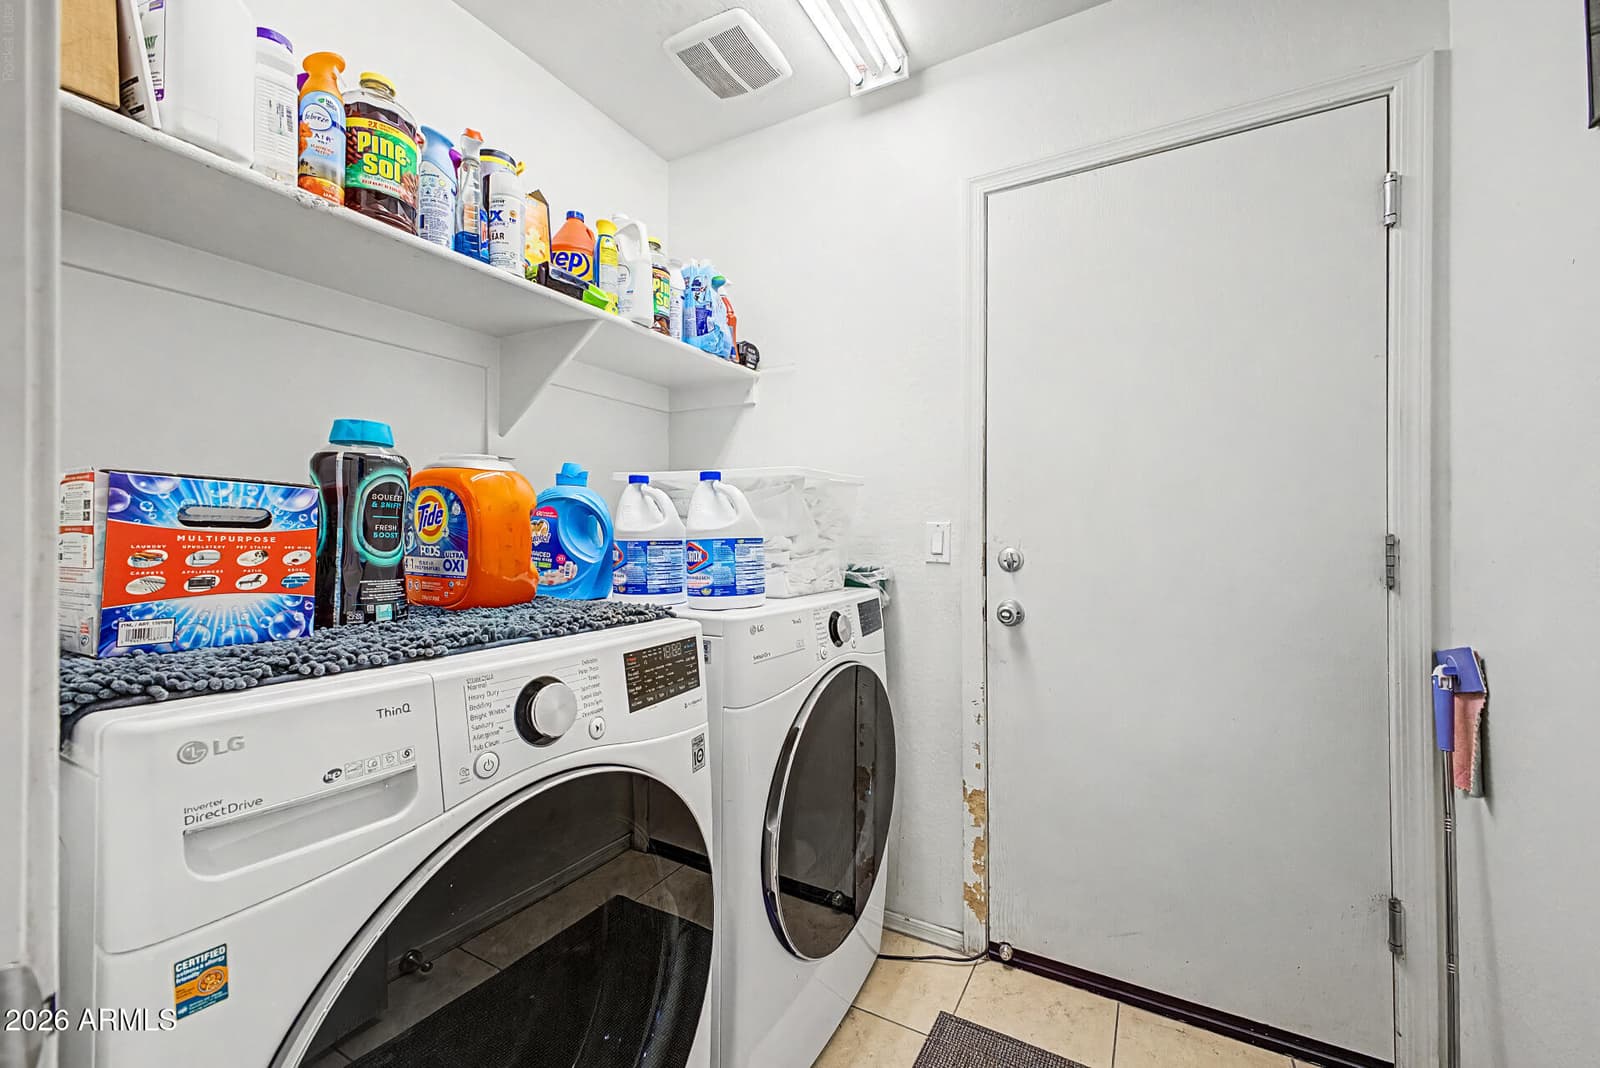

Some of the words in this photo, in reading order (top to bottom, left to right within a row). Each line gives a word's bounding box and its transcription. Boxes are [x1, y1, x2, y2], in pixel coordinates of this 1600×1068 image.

[551, 251, 583, 272] ep
[418, 503, 443, 532] Tide
[176, 535, 277, 543] MULTIPURPOSE
[420, 545, 440, 557] PODS
[444, 551, 465, 559] ULTRA
[442, 559, 465, 573] OXI
[375, 702, 412, 719] ThinQ
[212, 736, 246, 756] LG
[184, 799, 223, 814] Inverter
[175, 946, 226, 973] CERTIFIED
